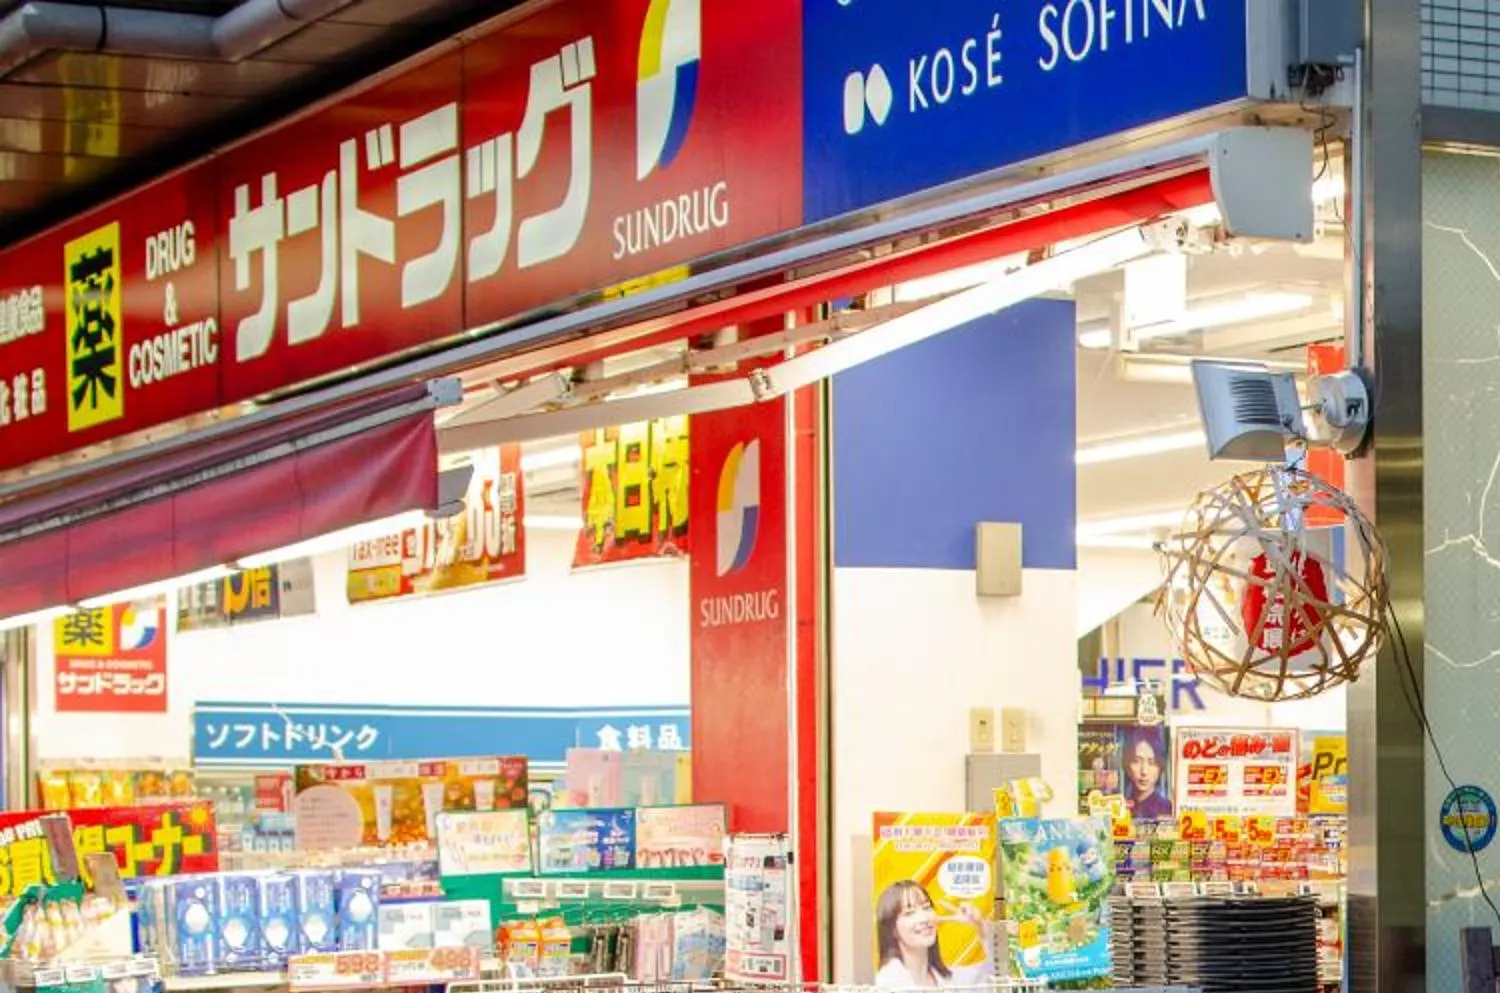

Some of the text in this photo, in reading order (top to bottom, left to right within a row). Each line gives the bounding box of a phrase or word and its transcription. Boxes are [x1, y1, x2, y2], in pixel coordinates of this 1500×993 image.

[908, 12, 1003, 113] KOSÉ
[228, 36, 597, 364] サンドラッグ
[612, 180, 730, 261] SUNDRUG
[145, 220, 196, 281] DRUG
[70, 245, 117, 411] 薬
[163, 282, 180, 327] &
[129, 317, 218, 389] COSMETIC
[700, 590, 780, 628] SUNDRUG
[57, 672, 165, 695] サンドラッグ
[207, 723, 379, 752] ソフトドリンク
[597, 724, 684, 752] 食料品
